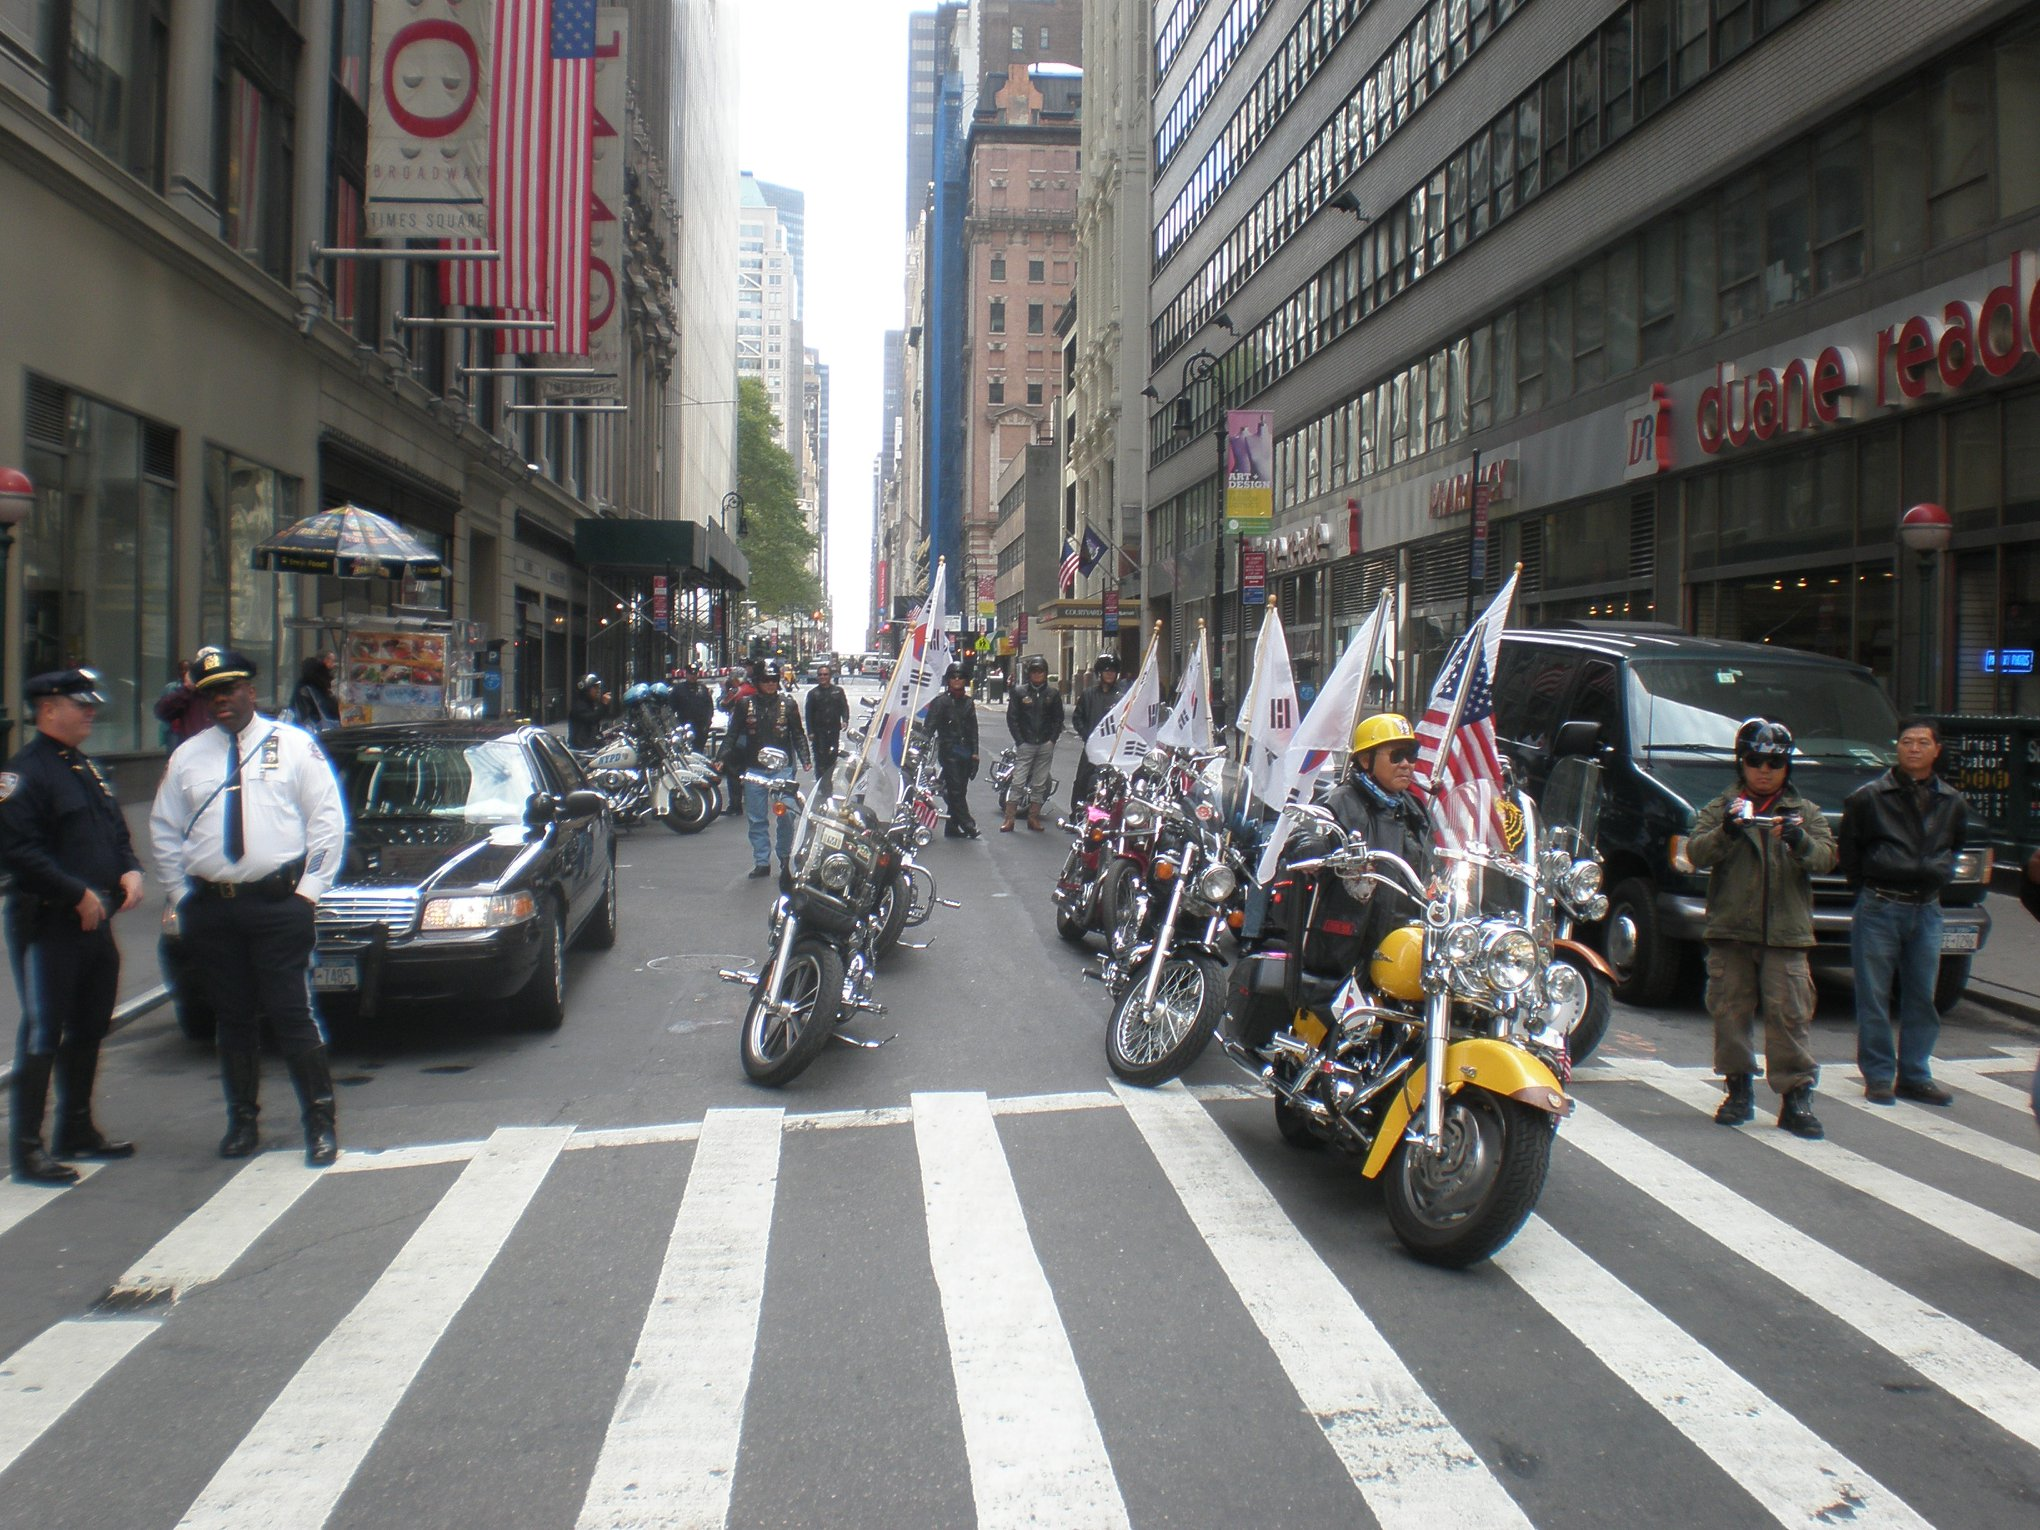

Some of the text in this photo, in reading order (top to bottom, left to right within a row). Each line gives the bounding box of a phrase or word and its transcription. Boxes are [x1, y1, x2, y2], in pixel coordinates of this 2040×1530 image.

[374, 164, 482, 180] BROADWAY
[371, 211, 483, 228] TIMES SQUARE
[1697, 346, 1858, 455] duane
[1228, 472, 1251, 481] ART
[1228, 480, 1271, 489] DESIGN
[598, 752, 622, 765] NYPD
